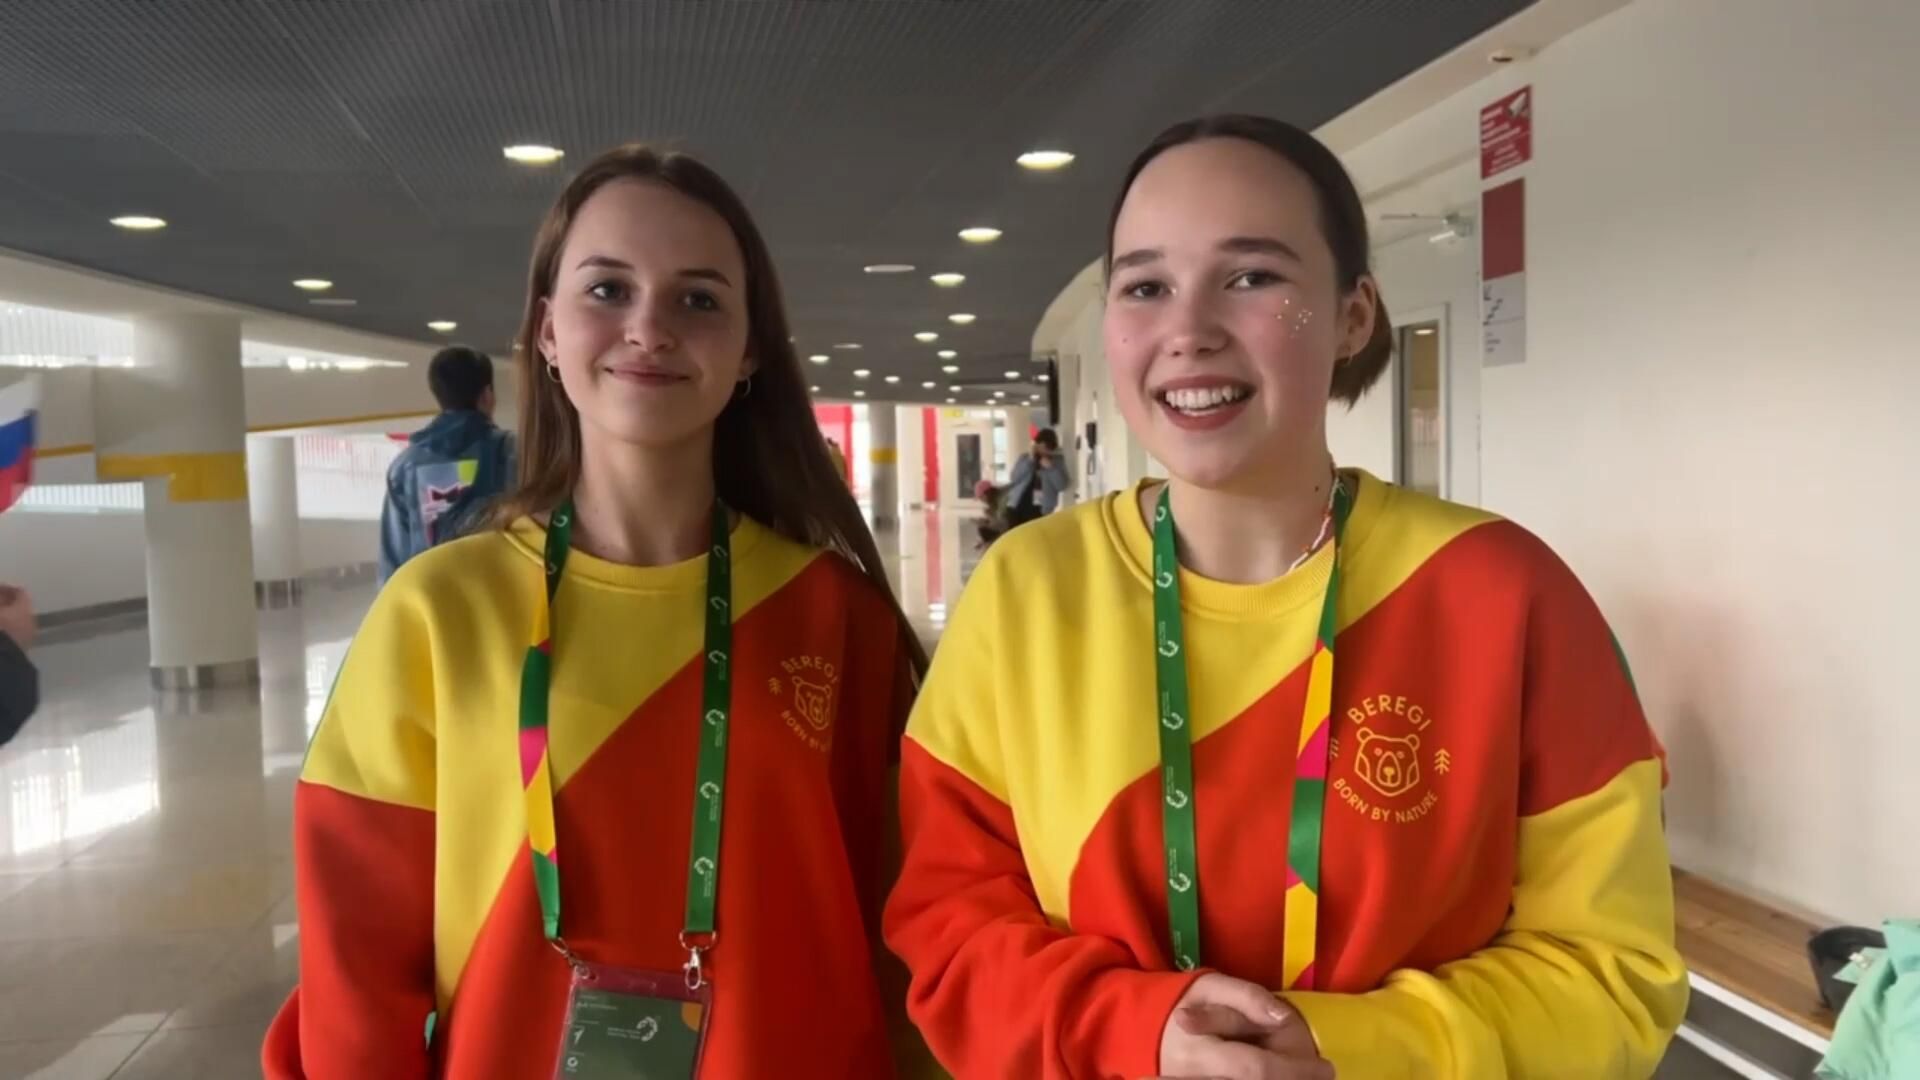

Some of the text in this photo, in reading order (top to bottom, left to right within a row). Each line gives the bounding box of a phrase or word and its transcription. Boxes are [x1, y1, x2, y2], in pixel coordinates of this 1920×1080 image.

[1347, 694, 1432, 731] BEREGI
[1333, 778, 1438, 823] BORN BY NATURE
